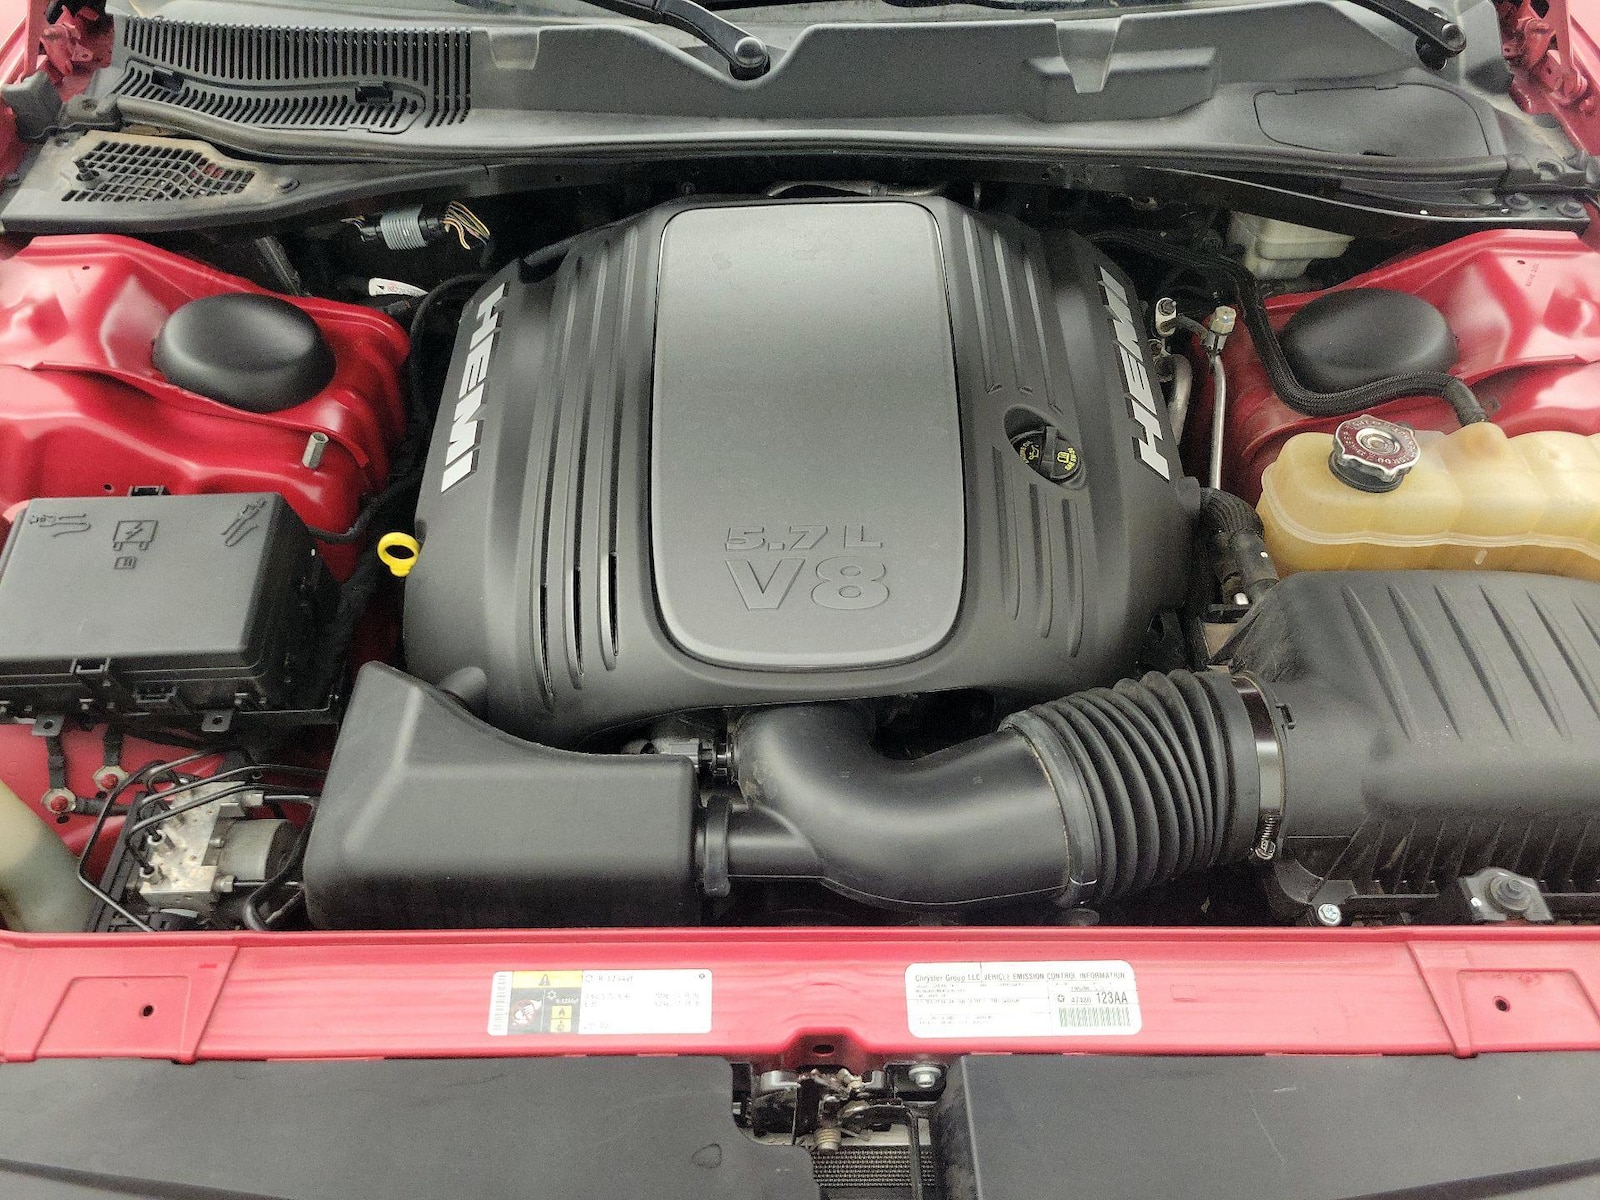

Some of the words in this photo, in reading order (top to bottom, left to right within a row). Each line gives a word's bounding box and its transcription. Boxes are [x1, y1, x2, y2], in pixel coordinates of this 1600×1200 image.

[441, 282, 505, 493] HEMI
[1100, 266, 1169, 480] HEMI
[724, 556, 890, 610] V8
[944, 974, 966, 982] Group
[983, 973, 1010, 981] VEHICLE
[1012, 972, 1044, 980] EMISSION
[1046, 972, 1076, 980] CONTROL
[1079, 971, 1125, 980] INFORMATION
[1095, 991, 1129, 1005] 123AA
